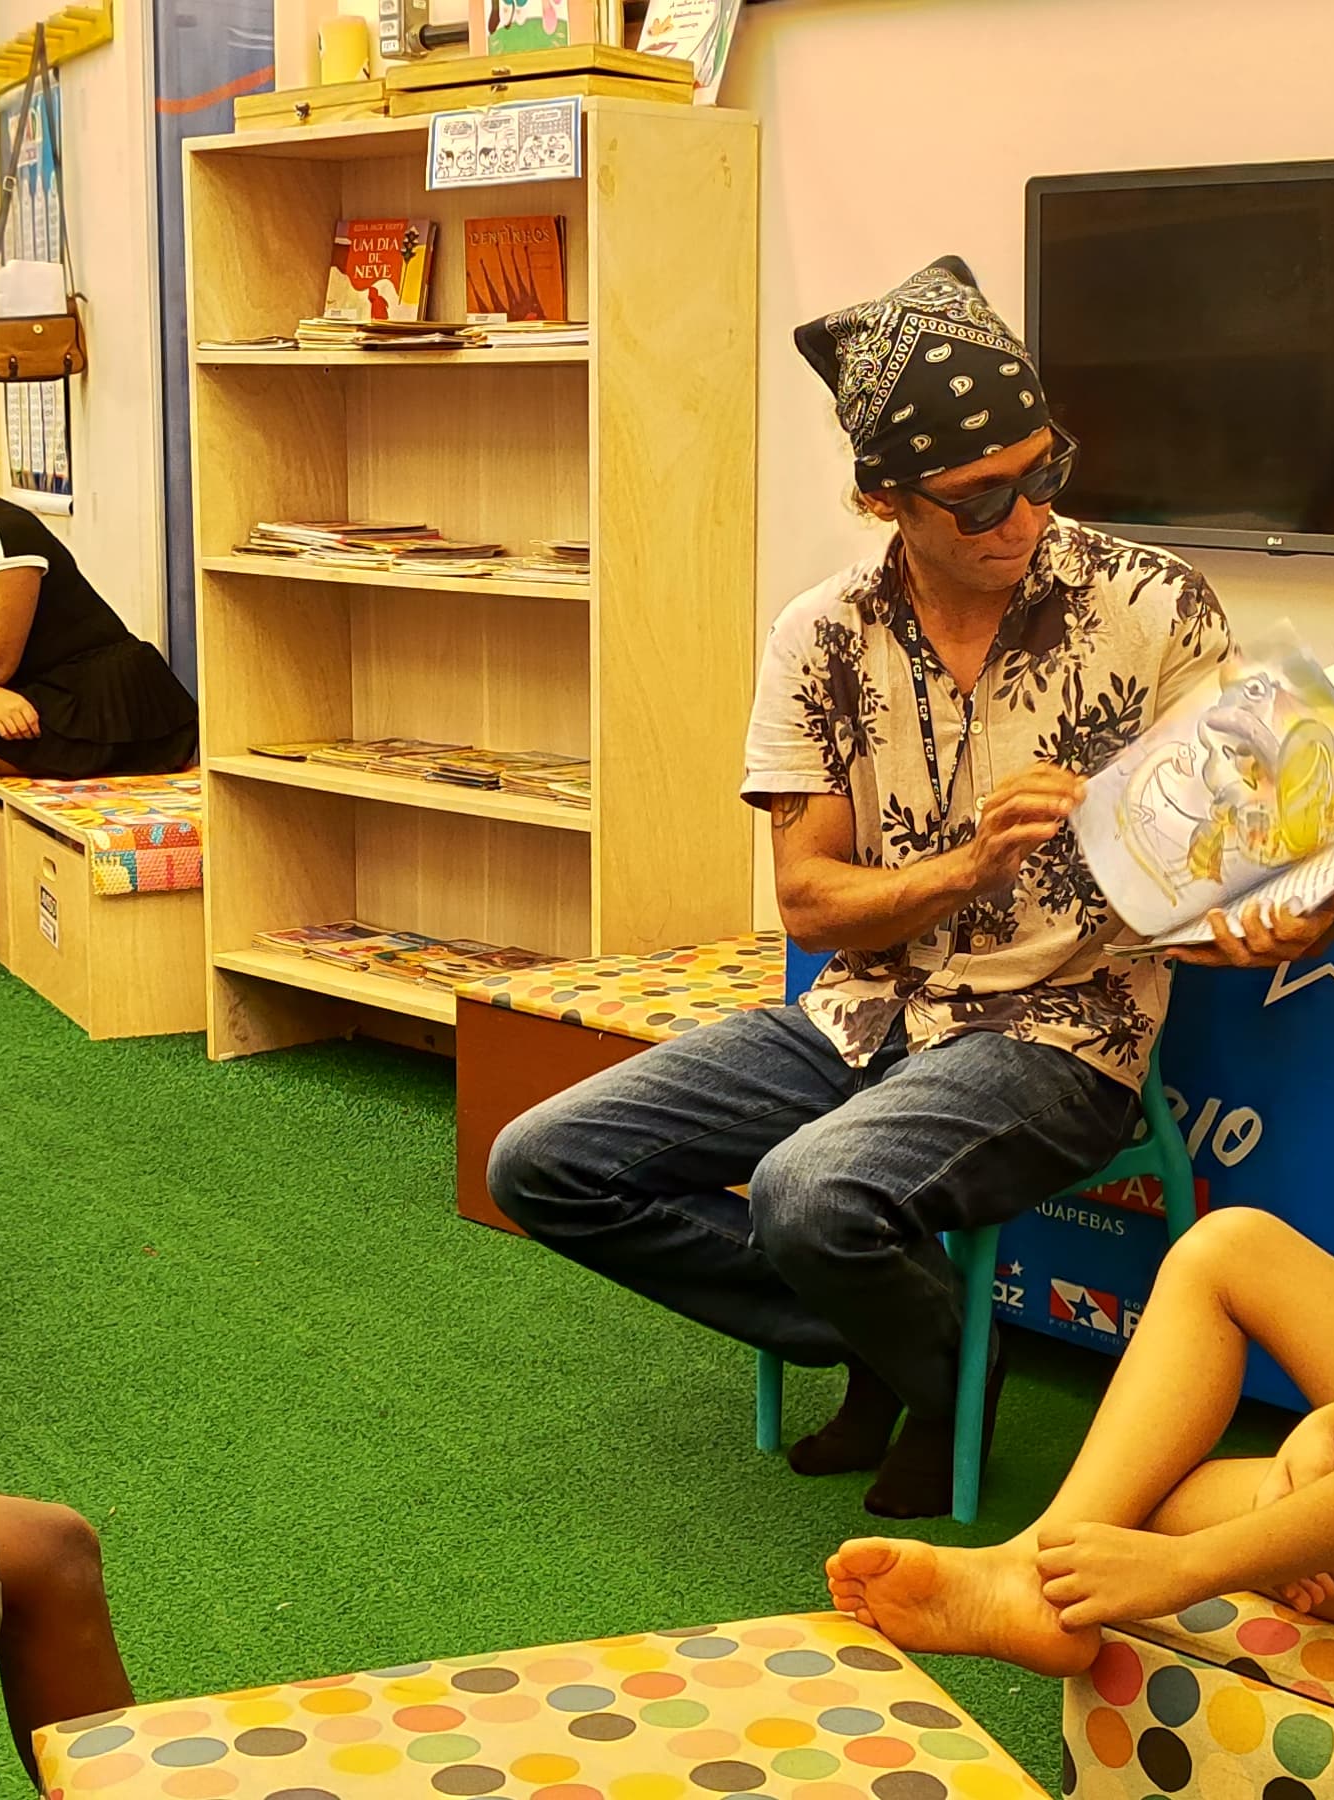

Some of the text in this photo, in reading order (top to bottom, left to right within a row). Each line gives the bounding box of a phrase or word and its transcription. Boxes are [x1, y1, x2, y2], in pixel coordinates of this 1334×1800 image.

[353, 237, 399, 252] UM DIA
[354, 264, 392, 279] NEVE
[907, 619, 917, 642] FCP
[912, 657, 923, 681] FCP
[918, 697, 929, 721] FCP
[924, 738, 934, 761] FCP
[1035, 1201, 1125, 1236] UAPEBAS
